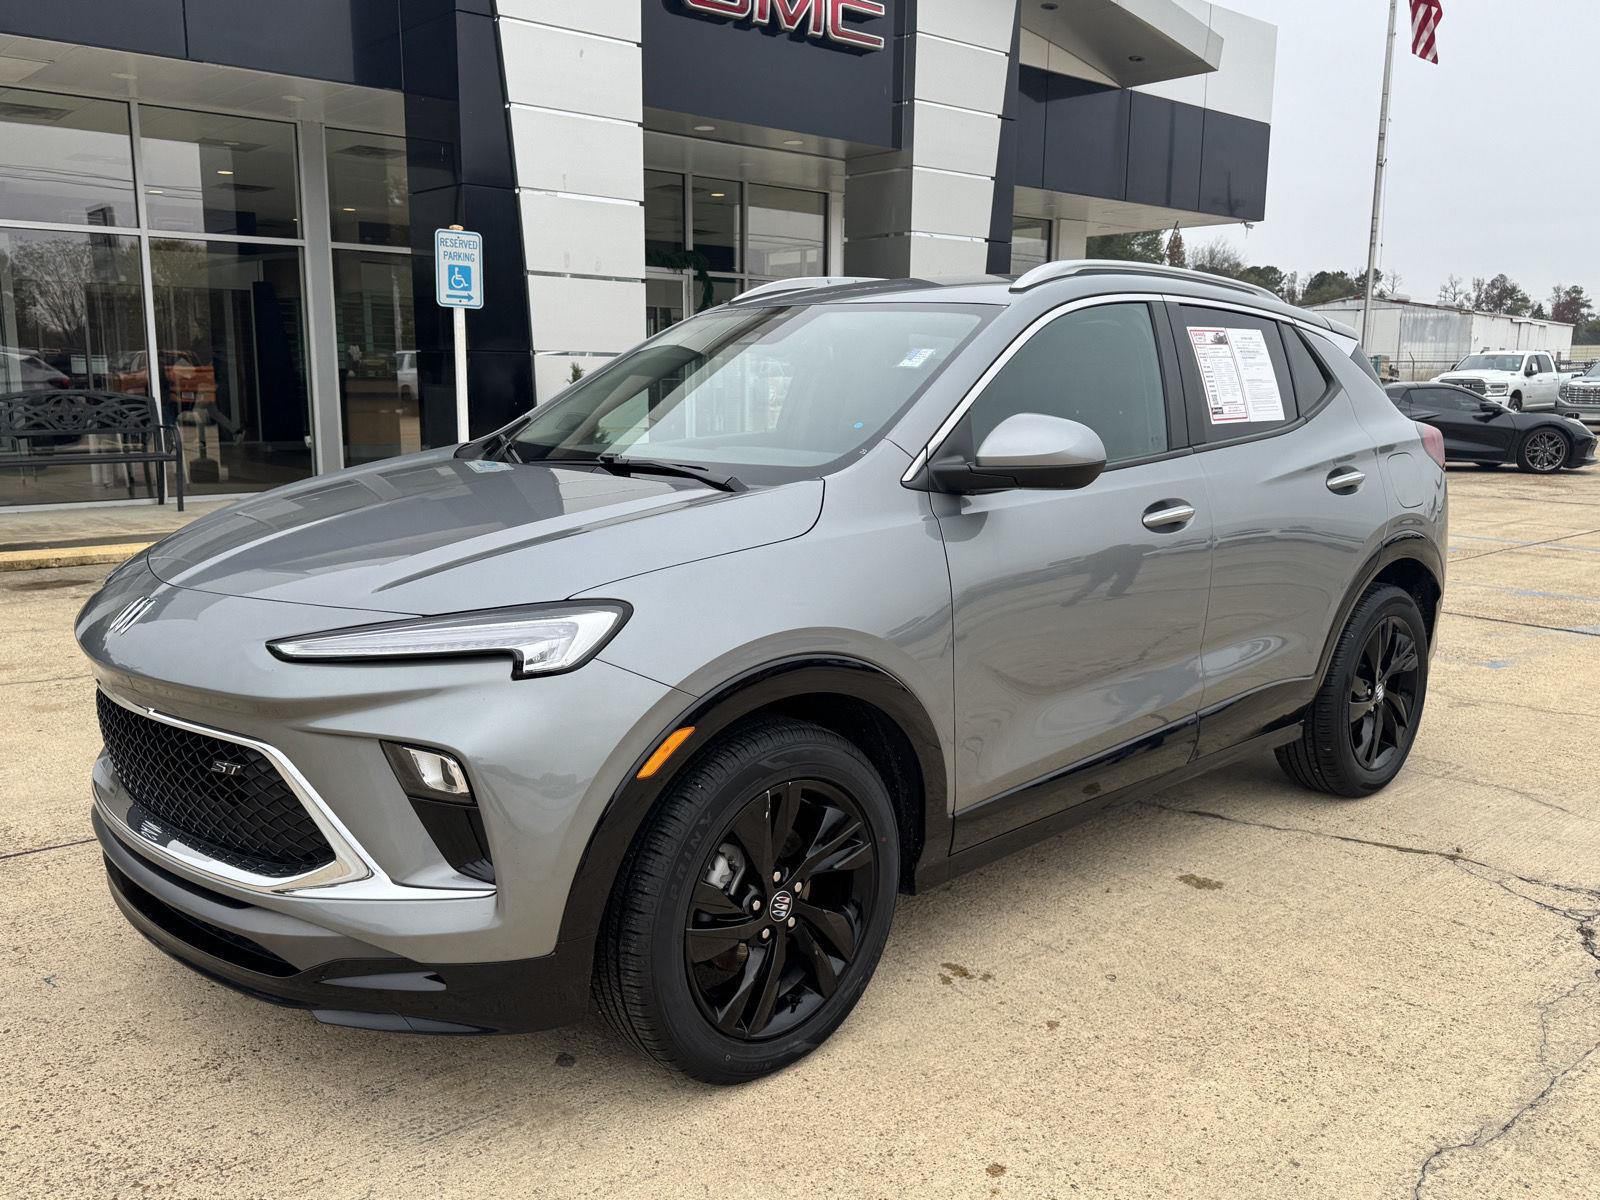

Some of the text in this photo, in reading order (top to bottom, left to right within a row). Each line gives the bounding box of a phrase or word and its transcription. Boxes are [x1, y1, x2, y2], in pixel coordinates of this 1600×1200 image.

[440, 238, 477, 250] RESERVED
[443, 251, 475, 262] PARKING
[211, 760, 242, 775] ST
